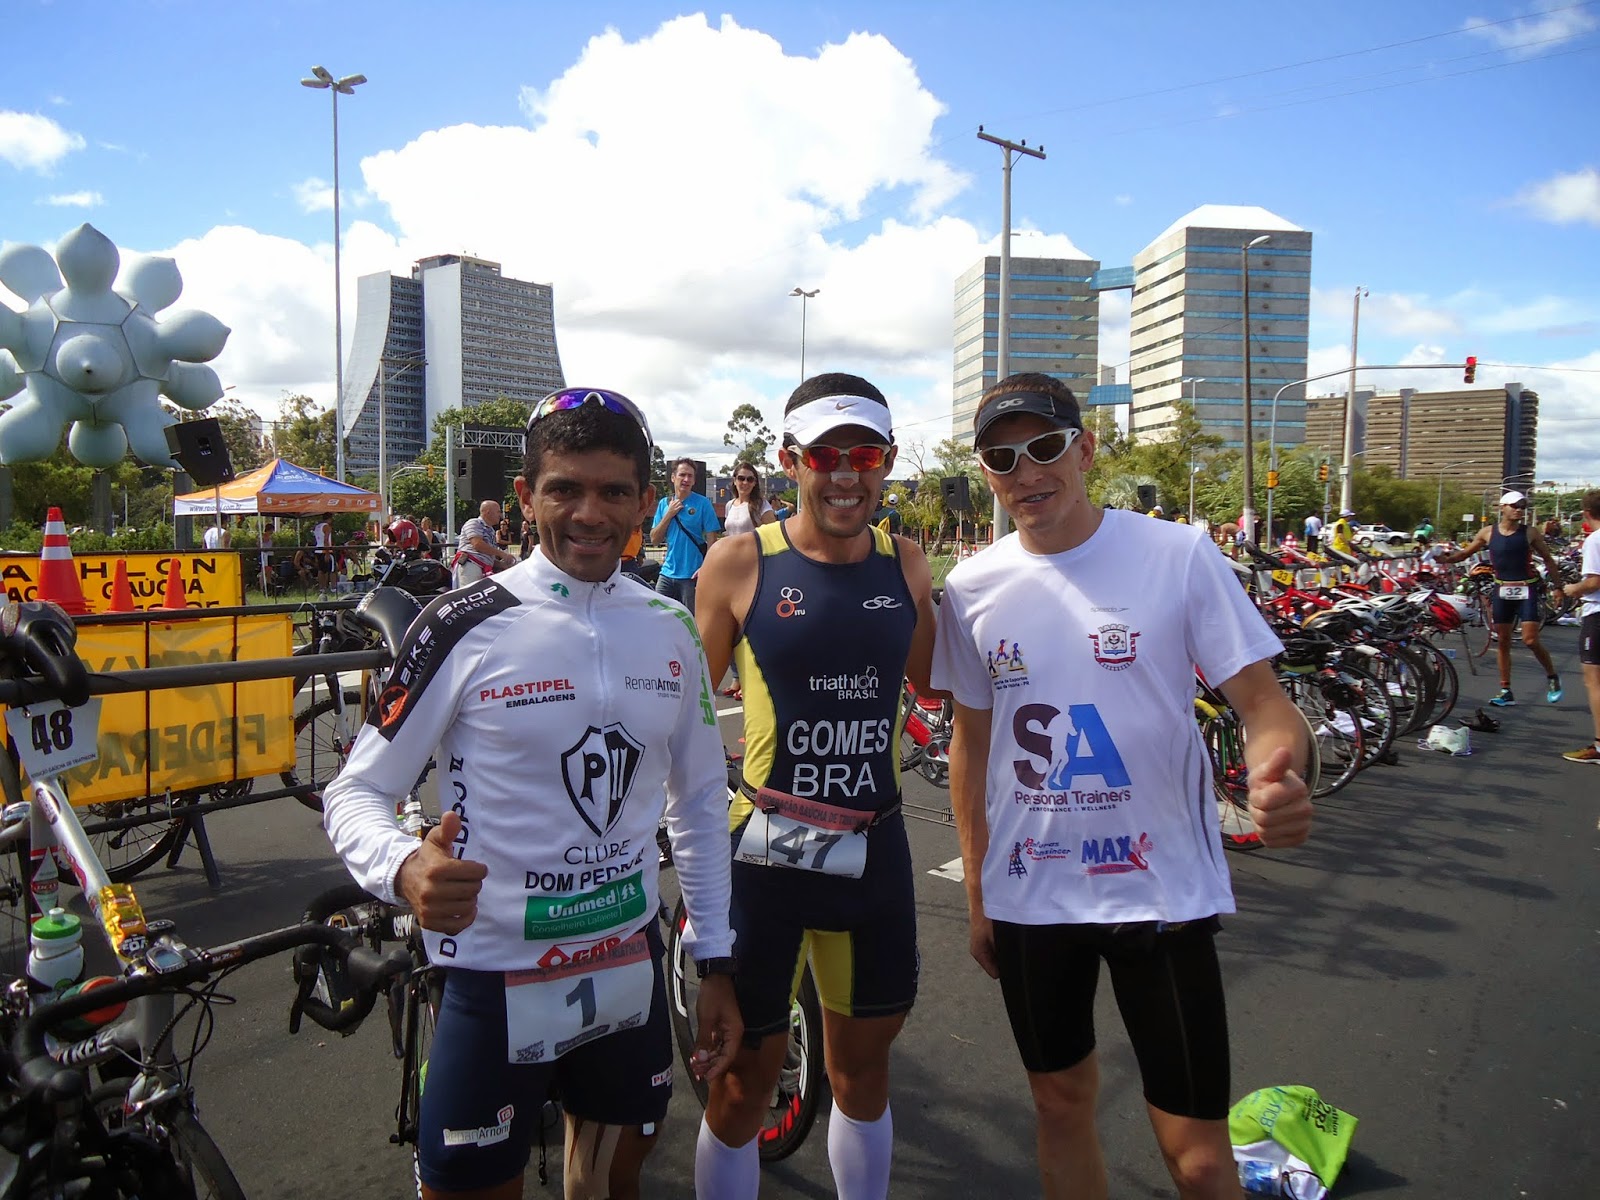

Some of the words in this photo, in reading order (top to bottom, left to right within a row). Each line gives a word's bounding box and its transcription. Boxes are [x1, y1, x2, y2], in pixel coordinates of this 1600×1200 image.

[1277, 570, 1289, 581] 33
[436, 585, 498, 621] SHOP
[1505, 587, 1523, 596] 32
[413, 639, 437, 680] AVELAR
[445, 597, 495, 626] DRUMOND
[480, 679, 575, 701] PLASTIPEL
[809, 673, 879, 691] triathlon
[506, 693, 576, 709] EMBALAGENS
[838, 690, 878, 700] BRASIL
[31, 709, 73, 755] 48
[787, 718, 890, 756] GOMES
[1012, 703, 1133, 791] SA
[792, 762, 877, 797] BRA
[1014, 791, 1068, 805] Personal
[1081, 804, 1117, 812] WELLNESS
[829, 813, 838, 823] DE
[564, 839, 631, 865] CLUBE
[770, 826, 843, 869] 47
[1081, 835, 1131, 865] MAX
[525, 871, 574, 892] DOM
[548, 889, 616, 919] Unimed
[532, 920, 586, 934] Conselheiro
[565, 977, 597, 1029] 1
